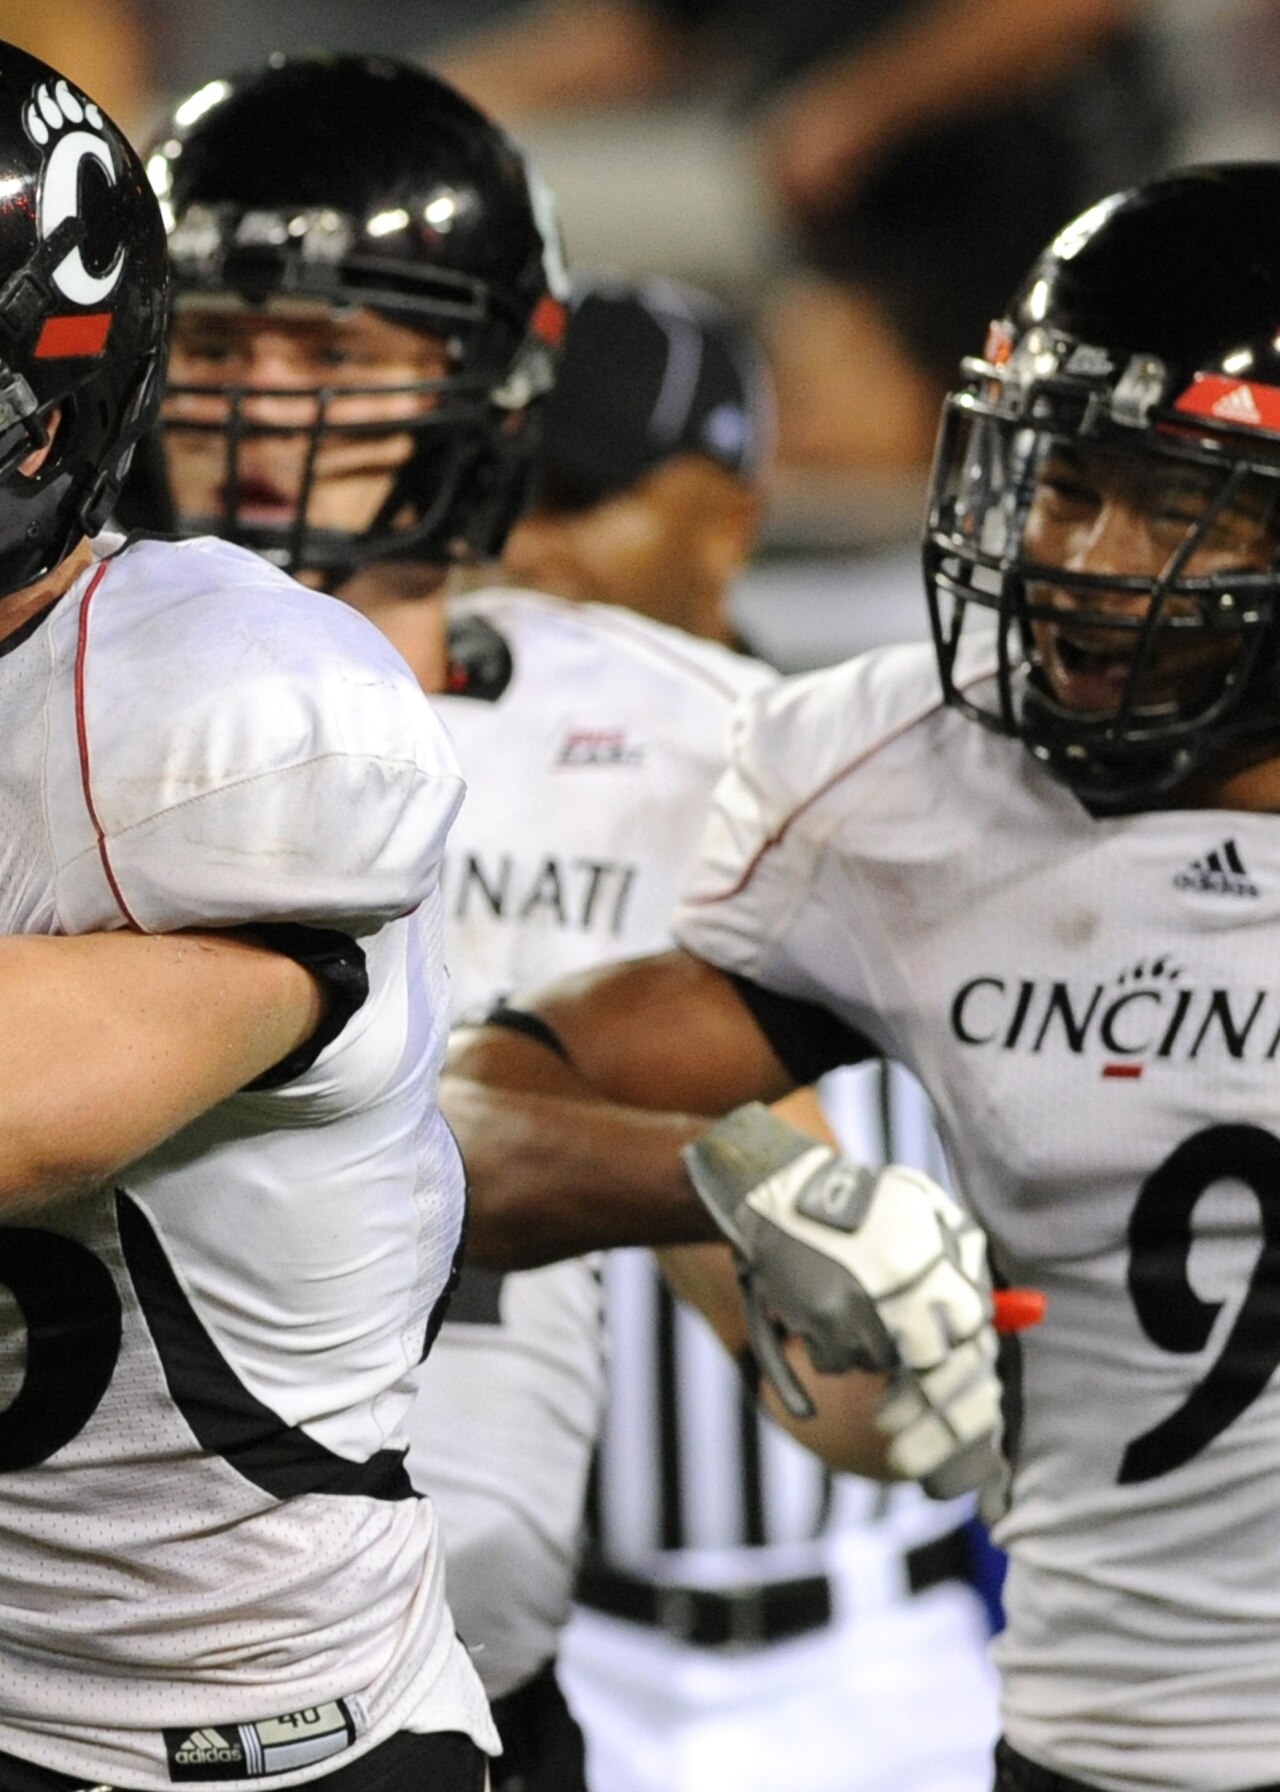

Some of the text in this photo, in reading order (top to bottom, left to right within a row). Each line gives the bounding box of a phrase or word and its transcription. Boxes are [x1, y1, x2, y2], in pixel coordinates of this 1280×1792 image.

[437, 852, 639, 936] NATI
[950, 977, 1280, 1061] CINCIN
[174, 1746, 242, 1765] adidas
